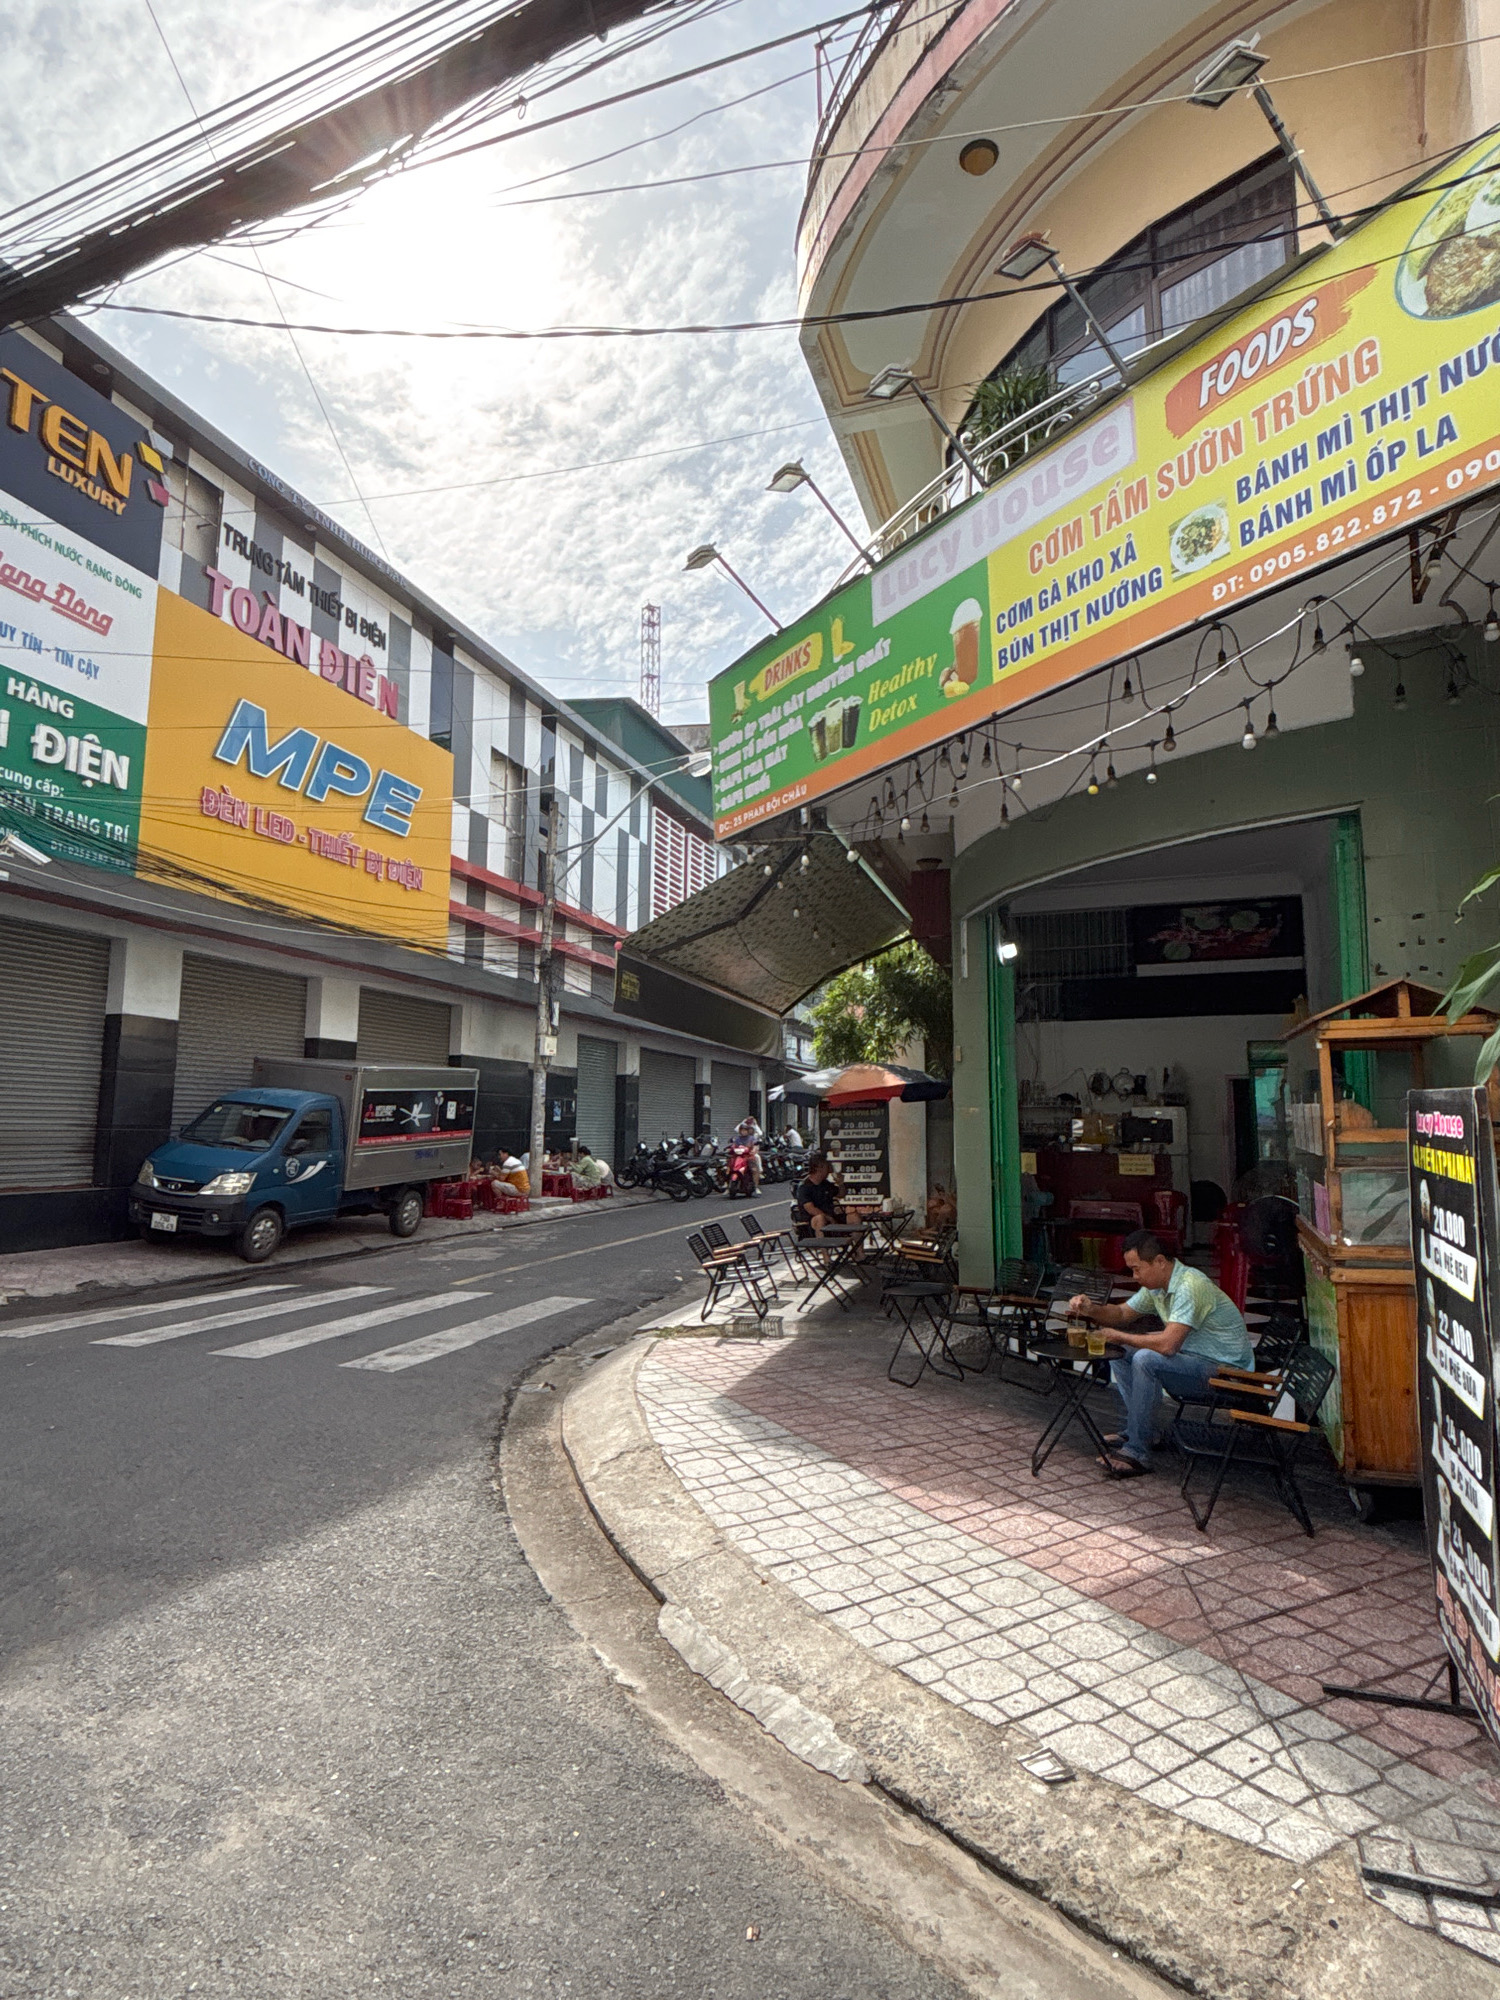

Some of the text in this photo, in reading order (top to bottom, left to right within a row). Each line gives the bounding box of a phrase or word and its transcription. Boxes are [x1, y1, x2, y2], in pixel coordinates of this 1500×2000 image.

[1198, 297, 1318, 410] FOODS
[1028, 339, 1379, 575] CƠM TẤM SƯỜN TRỨNG
[1236, 441, 1309, 504] BÁNH
[1316, 413, 1354, 461] MÌ
[1360, 374, 1428, 434] THỊT
[48, 455, 126, 516] LUXURY
[1239, 414, 1459, 548] BÁNH MÌ ỐP LA
[0, 550, 47, 603] ang
[20, 522, 52, 549] PHÍCH
[54, 540, 84, 566] NƯỚC
[86, 558, 112, 583] RẠNG
[115, 574, 143, 600] ĐÔNG
[1212, 576, 1244, 602] ĐT:
[1250, 488, 1423, 583] 0905.822.872
[224, 522, 386, 651] TRUNG TÂM THIẾT BỊ ĐIỆN
[996, 532, 1137, 634] CƠM GÀ KHO XẢ
[206, 565, 311, 671] TOÀN
[998, 567, 1163, 670] BÚN THỊT NƯỚNG
[22, 631, 43, 655] TÍN
[55, 646, 74, 669] TIN
[78, 658, 100, 681] CẬY
[764, 641, 812, 692] DRINKS
[868, 653, 938, 705] Healthy
[7, 677, 74, 719] HÀNG
[869, 693, 918, 732] Detox
[30, 723, 130, 790] ĐIỆN
[35, 778, 65, 798] cấp:
[214, 697, 424, 838] MPE
[42, 802, 100, 836] TRANG
[104, 820, 130, 844] TRÍ
[201, 784, 250, 829] ĐÈN
[254, 806, 296, 844] LED
[308, 827, 362, 868] THIẾT
[364, 849, 383, 882] BỊ
[387, 857, 424, 891] ĐIỆN
[733, 815, 743, 826] 25
[744, 805, 765, 822] PHAN
[766, 795, 780, 816] BỘI
[782, 784, 807, 804] CHÂU
[1434, 1206, 1466, 1247] 20.000
[1438, 1310, 1474, 1363] 22.000
